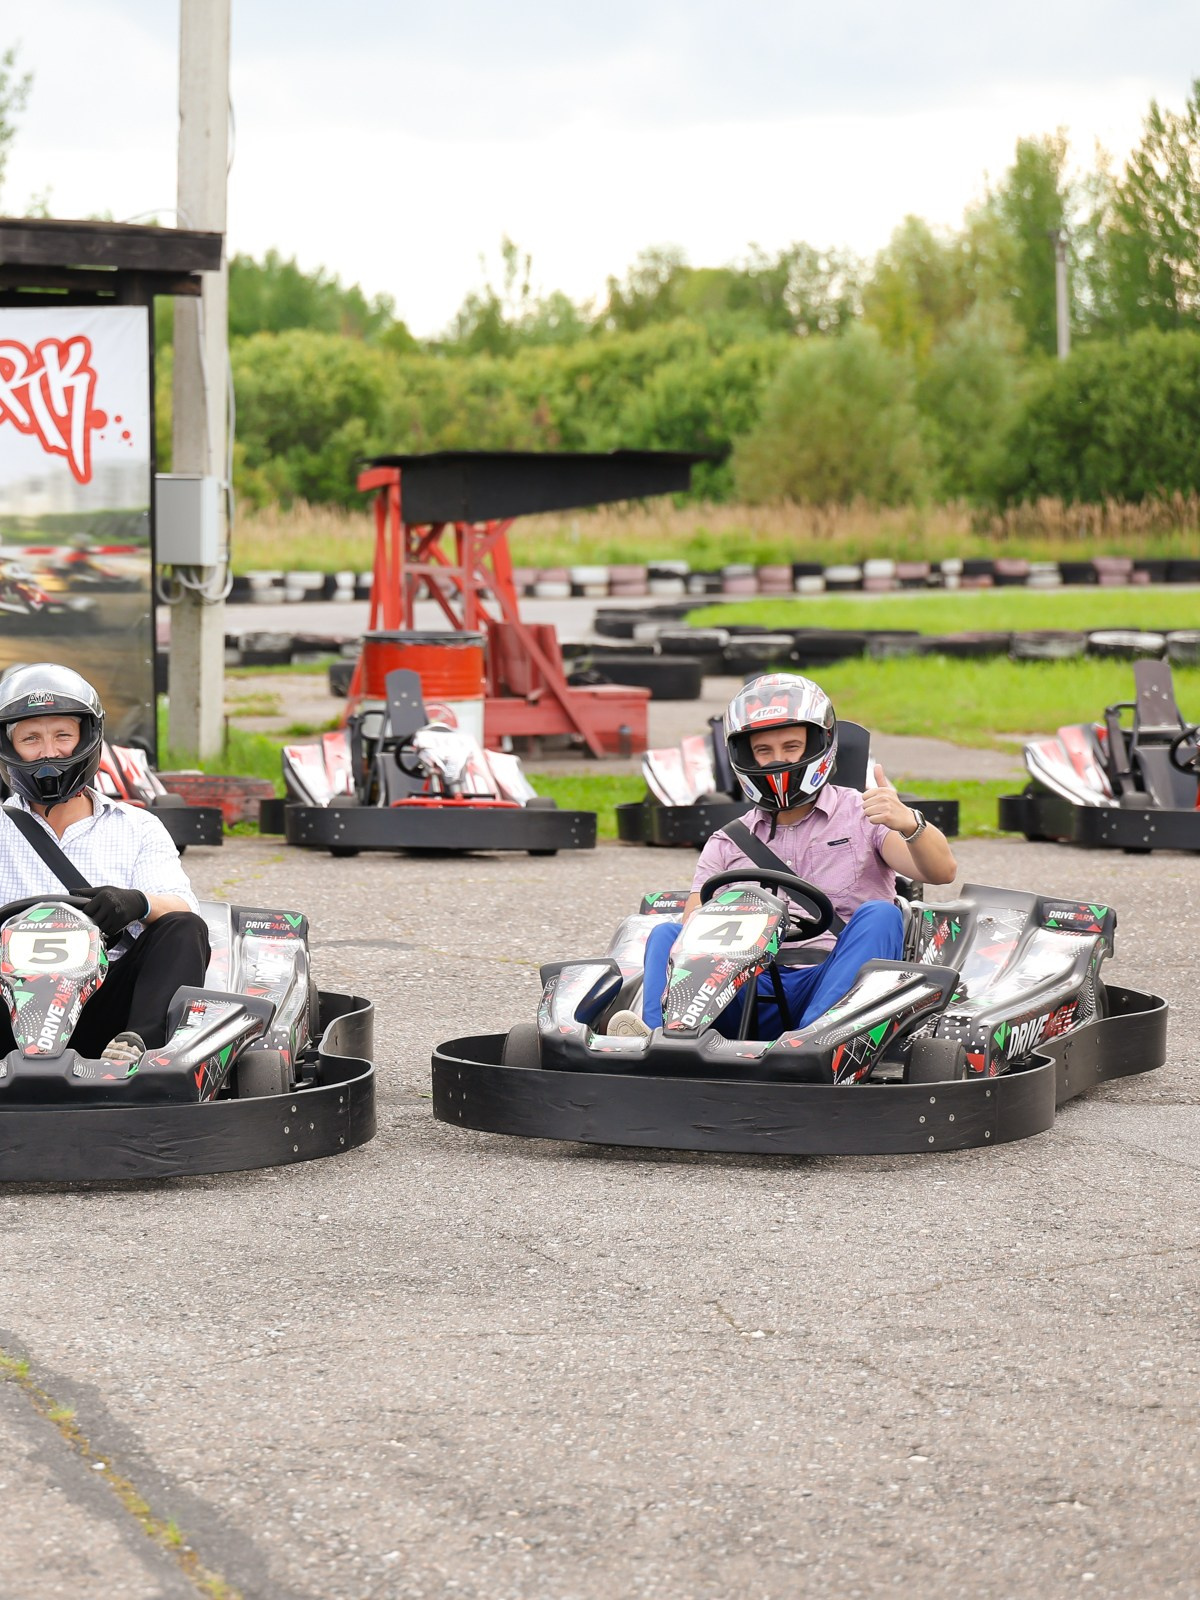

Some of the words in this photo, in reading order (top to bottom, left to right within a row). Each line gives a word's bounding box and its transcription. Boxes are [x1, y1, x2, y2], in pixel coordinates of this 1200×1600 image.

[705, 905, 764, 913] DRIVEPARK
[1049, 910, 1095, 922] DRIVEPARK
[19, 922, 80, 930] DRIVEPARK
[246, 921, 291, 931] DRIVEPARK
[697, 921, 744, 946] 4
[28, 938, 69, 965] 5
